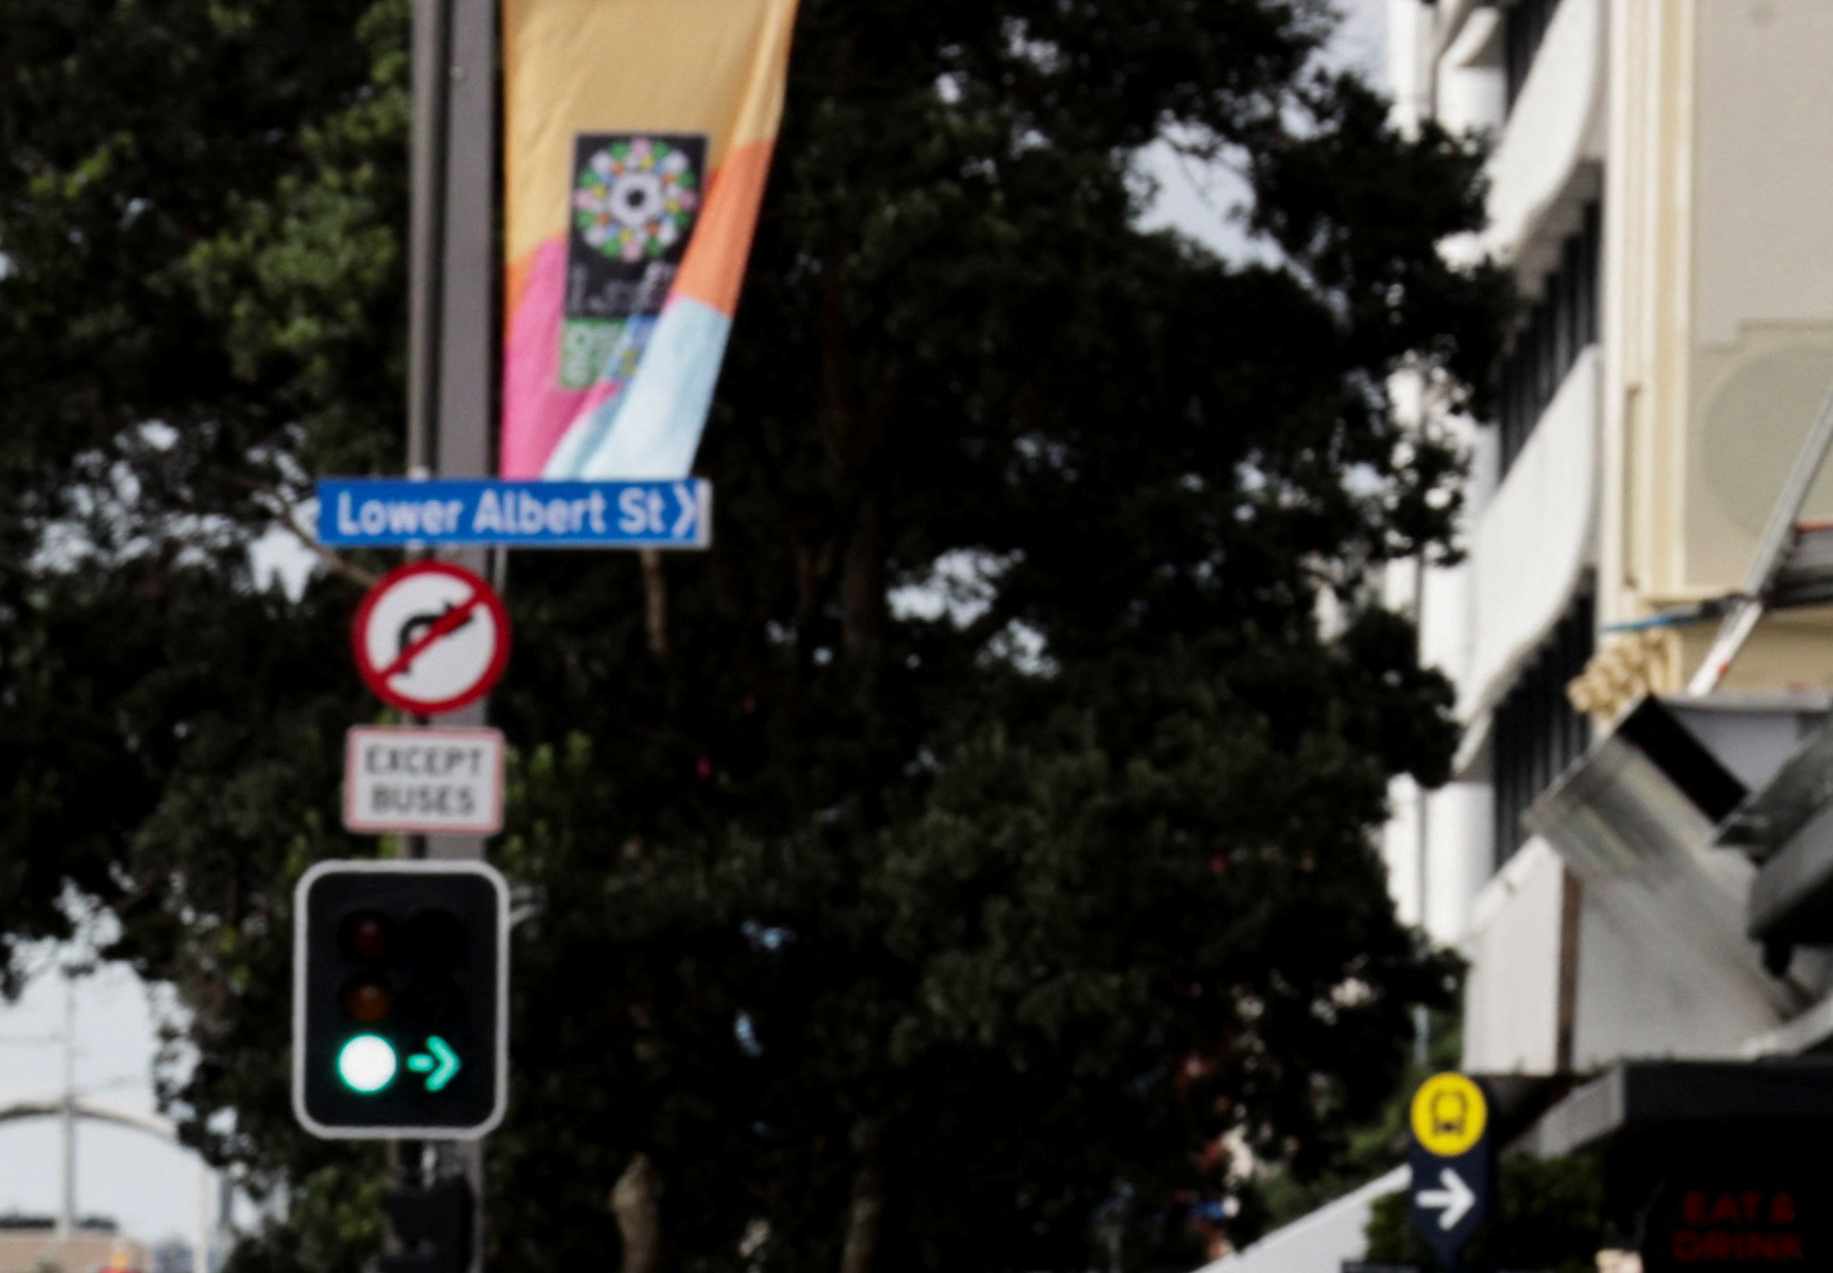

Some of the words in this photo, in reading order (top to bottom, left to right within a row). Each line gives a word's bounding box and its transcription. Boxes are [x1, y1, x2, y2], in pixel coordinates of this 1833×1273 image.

[338, 490, 464, 537] Lower
[472, 489, 607, 535] Albert
[618, 487, 664, 534] St
[364, 745, 484, 775] EXCEPT
[370, 785, 475, 816] BUSES
[1683, 1190, 1762, 1224] EAT
[1771, 1190, 1796, 1224] &
[1671, 1230, 1805, 1263] DRINK
